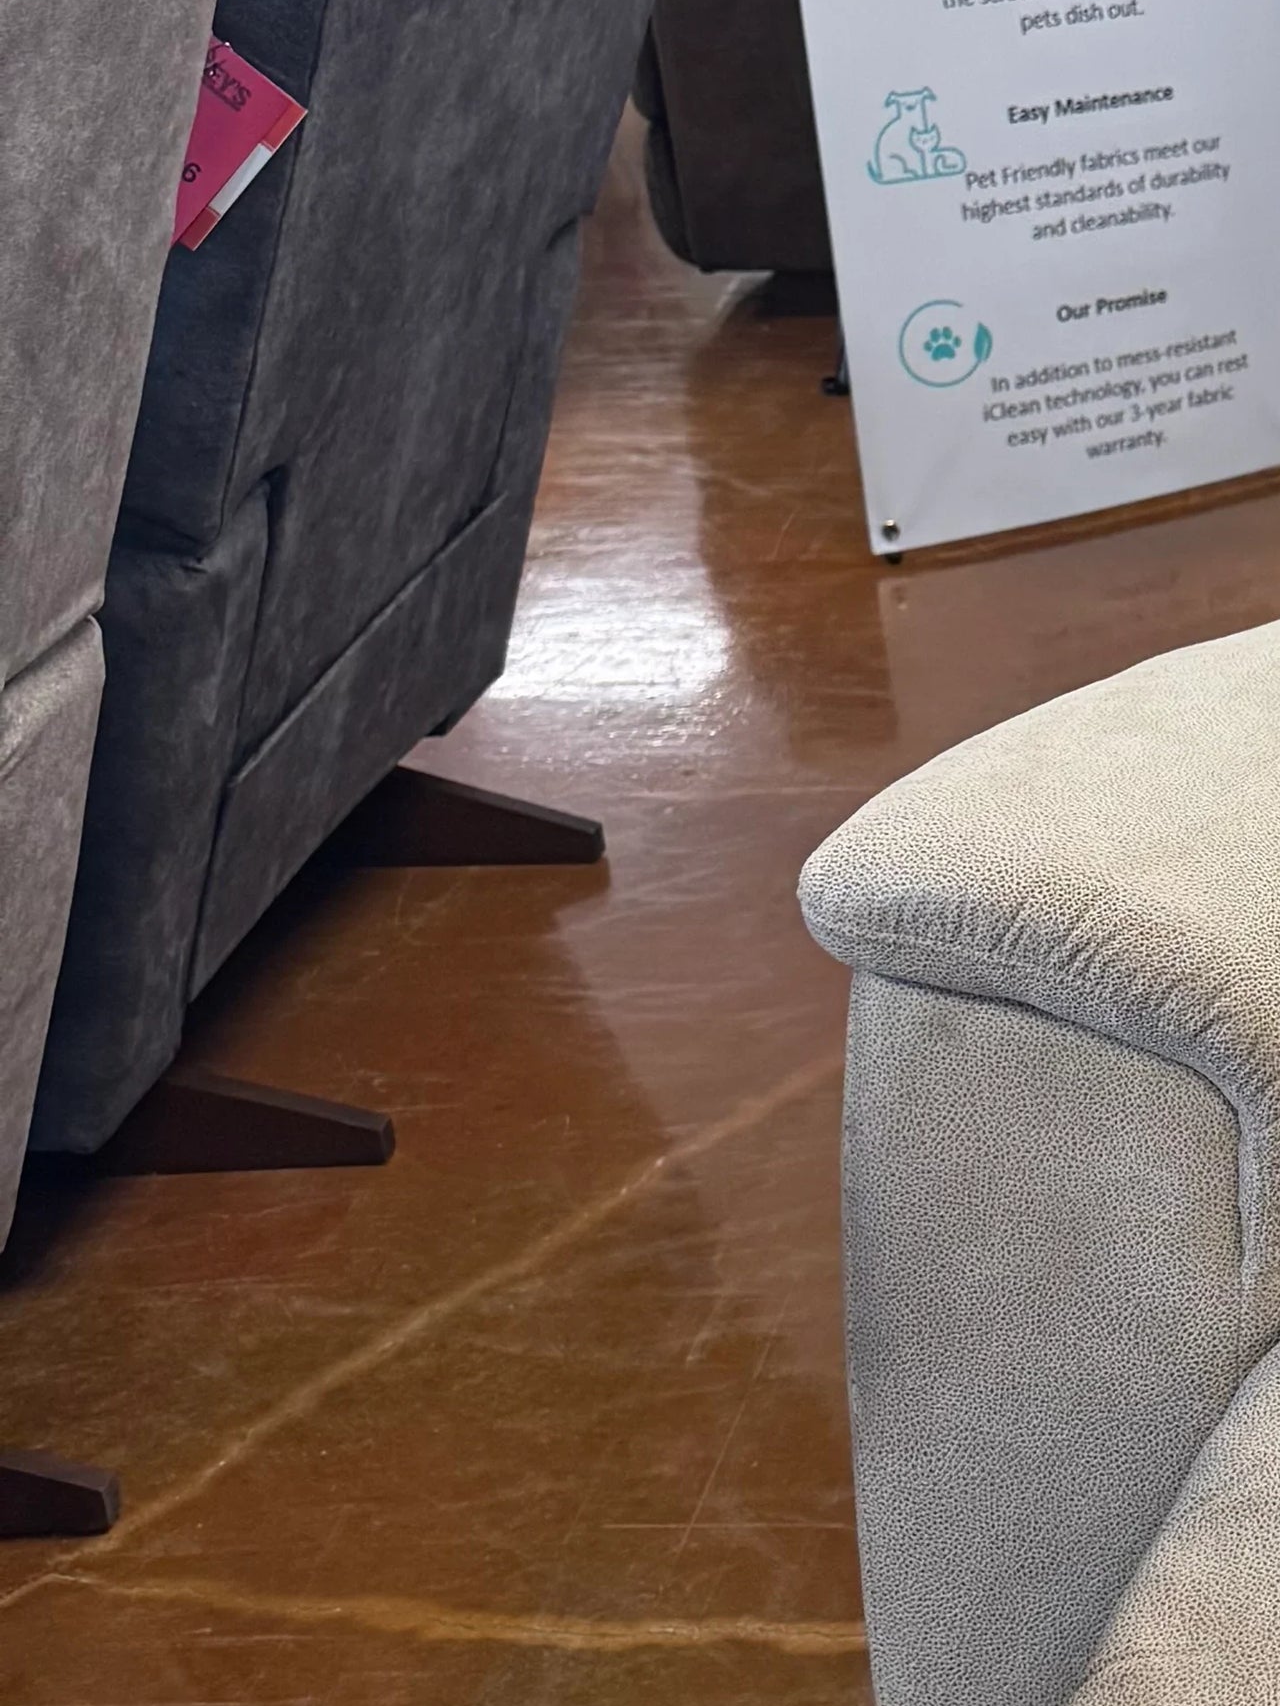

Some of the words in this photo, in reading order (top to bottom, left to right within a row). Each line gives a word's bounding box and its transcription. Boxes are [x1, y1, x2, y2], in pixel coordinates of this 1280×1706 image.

[1020, 10, 1062, 35] pets
[1065, 3, 1104, 25] dish
[1007, 105, 1050, 125] Easy
[1054, 86, 1174, 117] Maintenance
[965, 169, 997, 191] Pet
[1001, 157, 1076, 185] Friendly
[1080, 149, 1140, 172] fabrics
[1143, 139, 1188, 161] meet
[1192, 137, 1220, 154] our
[961, 195, 1031, 223] highest
[1035, 180, 1124, 210] standards
[1128, 174, 1145, 194] of
[1150, 163, 1230, 190] durability
[1032, 218, 1067, 240] and
[1056, 303, 1091, 323] Our
[1095, 289, 1168, 315] Promise
[982, 400, 1041, 422] iClean
[1149, 372, 1180, 393] you
[1185, 364, 1214, 381] can
[1218, 354, 1248, 373] rest
[991, 377, 1010, 393] In
[1015, 362, 1090, 389] addition
[1093, 357, 1113, 373] to
[1116, 330, 1237, 368] mess-resistant
[1007, 428, 1048, 447] easy
[1052, 416, 1092, 438] with
[1096, 411, 1124, 429] our
[1130, 398, 1182, 421] 3-year
[1187, 386, 1233, 407] fabric
